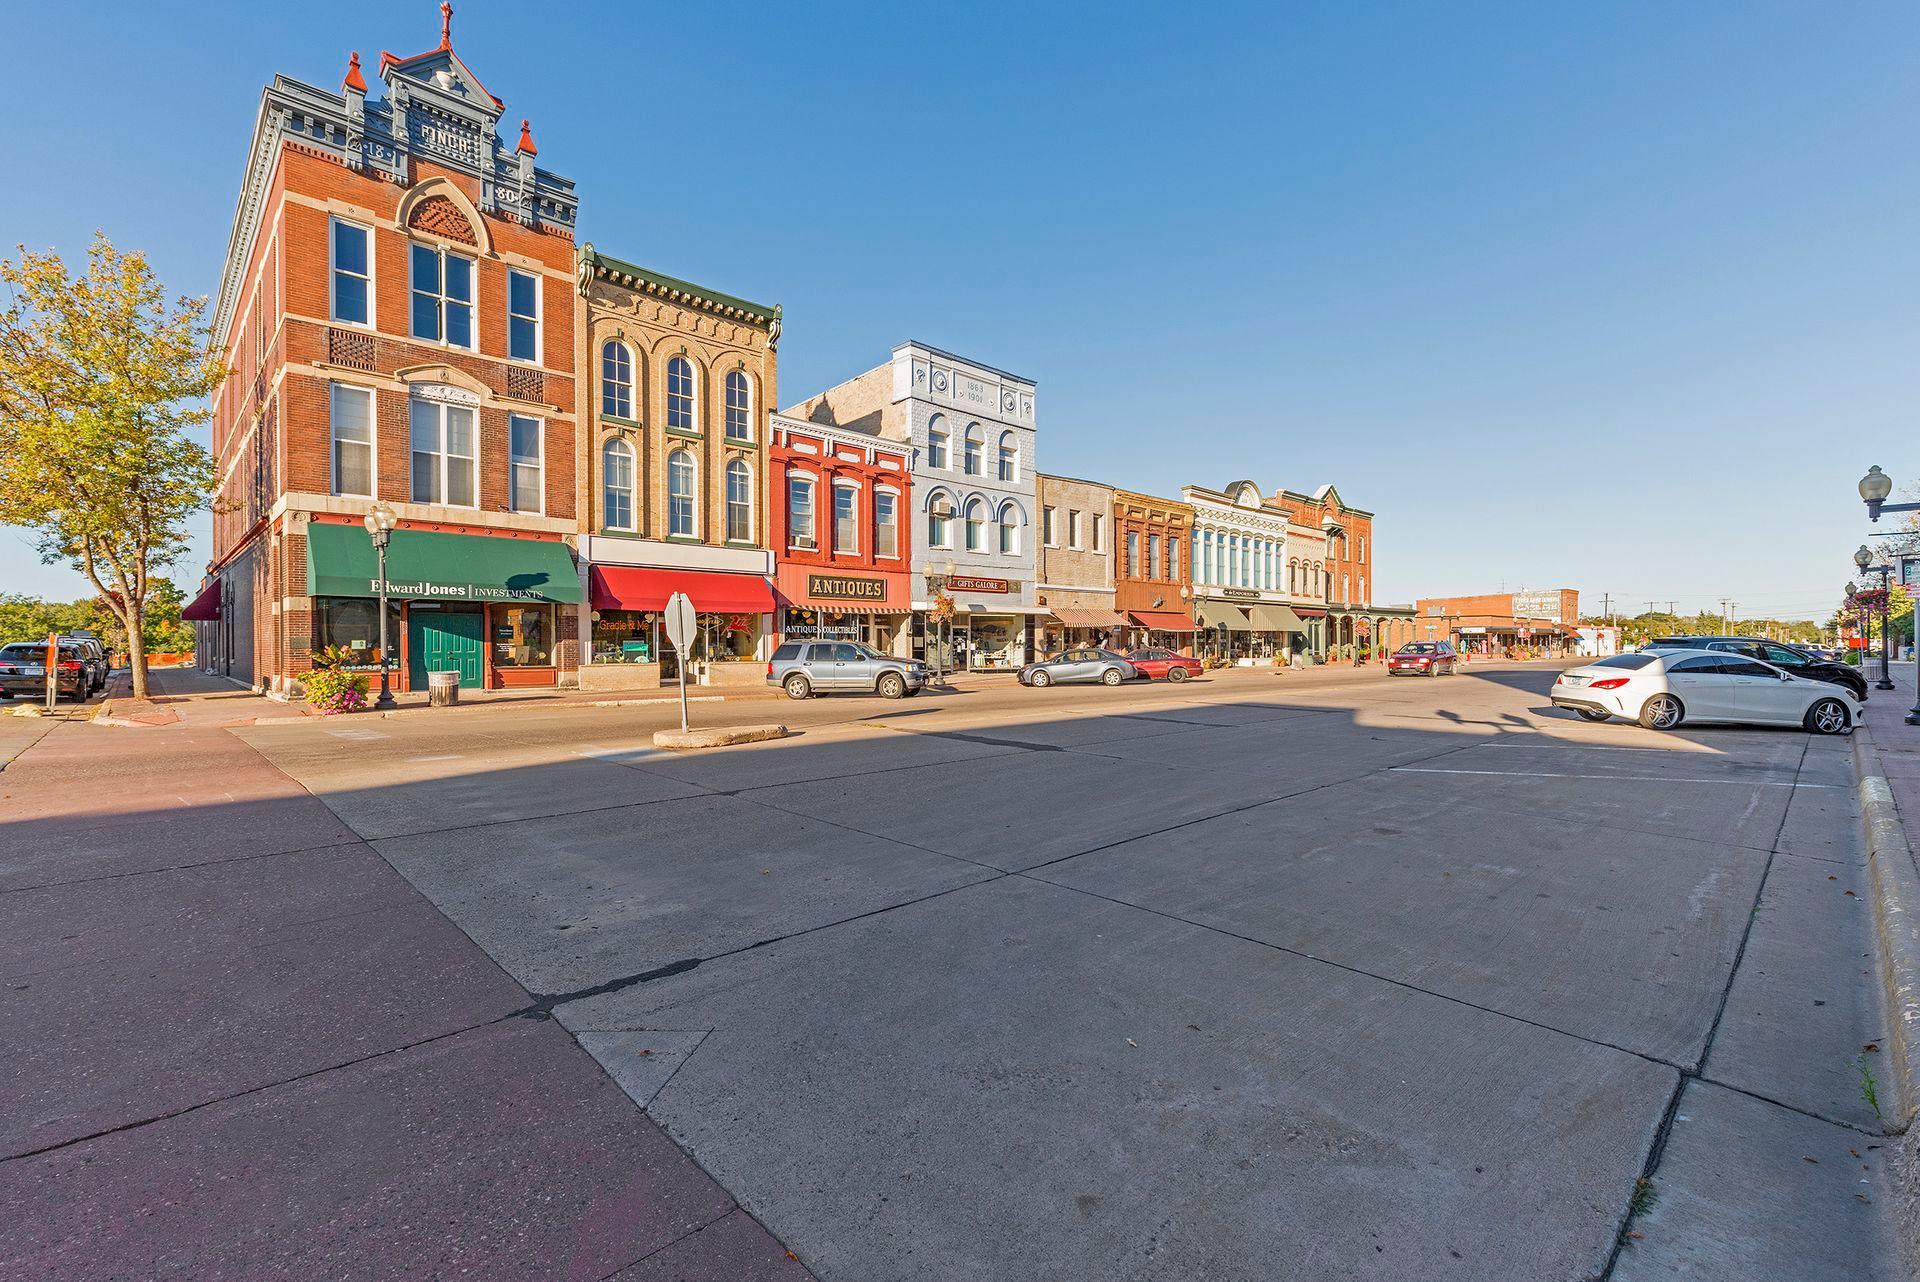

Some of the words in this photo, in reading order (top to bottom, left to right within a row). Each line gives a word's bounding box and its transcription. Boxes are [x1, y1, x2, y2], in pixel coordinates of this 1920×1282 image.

[421, 125, 468, 153] FINCH
[368, 141, 385, 158] 18
[497, 187, 515, 202] 80
[967, 381, 984, 393] 1863
[968, 392, 983, 403] 1901
[424, 582, 466, 596] Jones
[474, 587, 544, 598] INVESTMENTS
[812, 579, 882, 596] ANTIQUES
[957, 580, 974, 588] GIFTS
[975, 580, 998, 589] GALORE
[600, 619, 627, 631] Gracie
[823, 625, 858, 634] COLLECTIBLES
